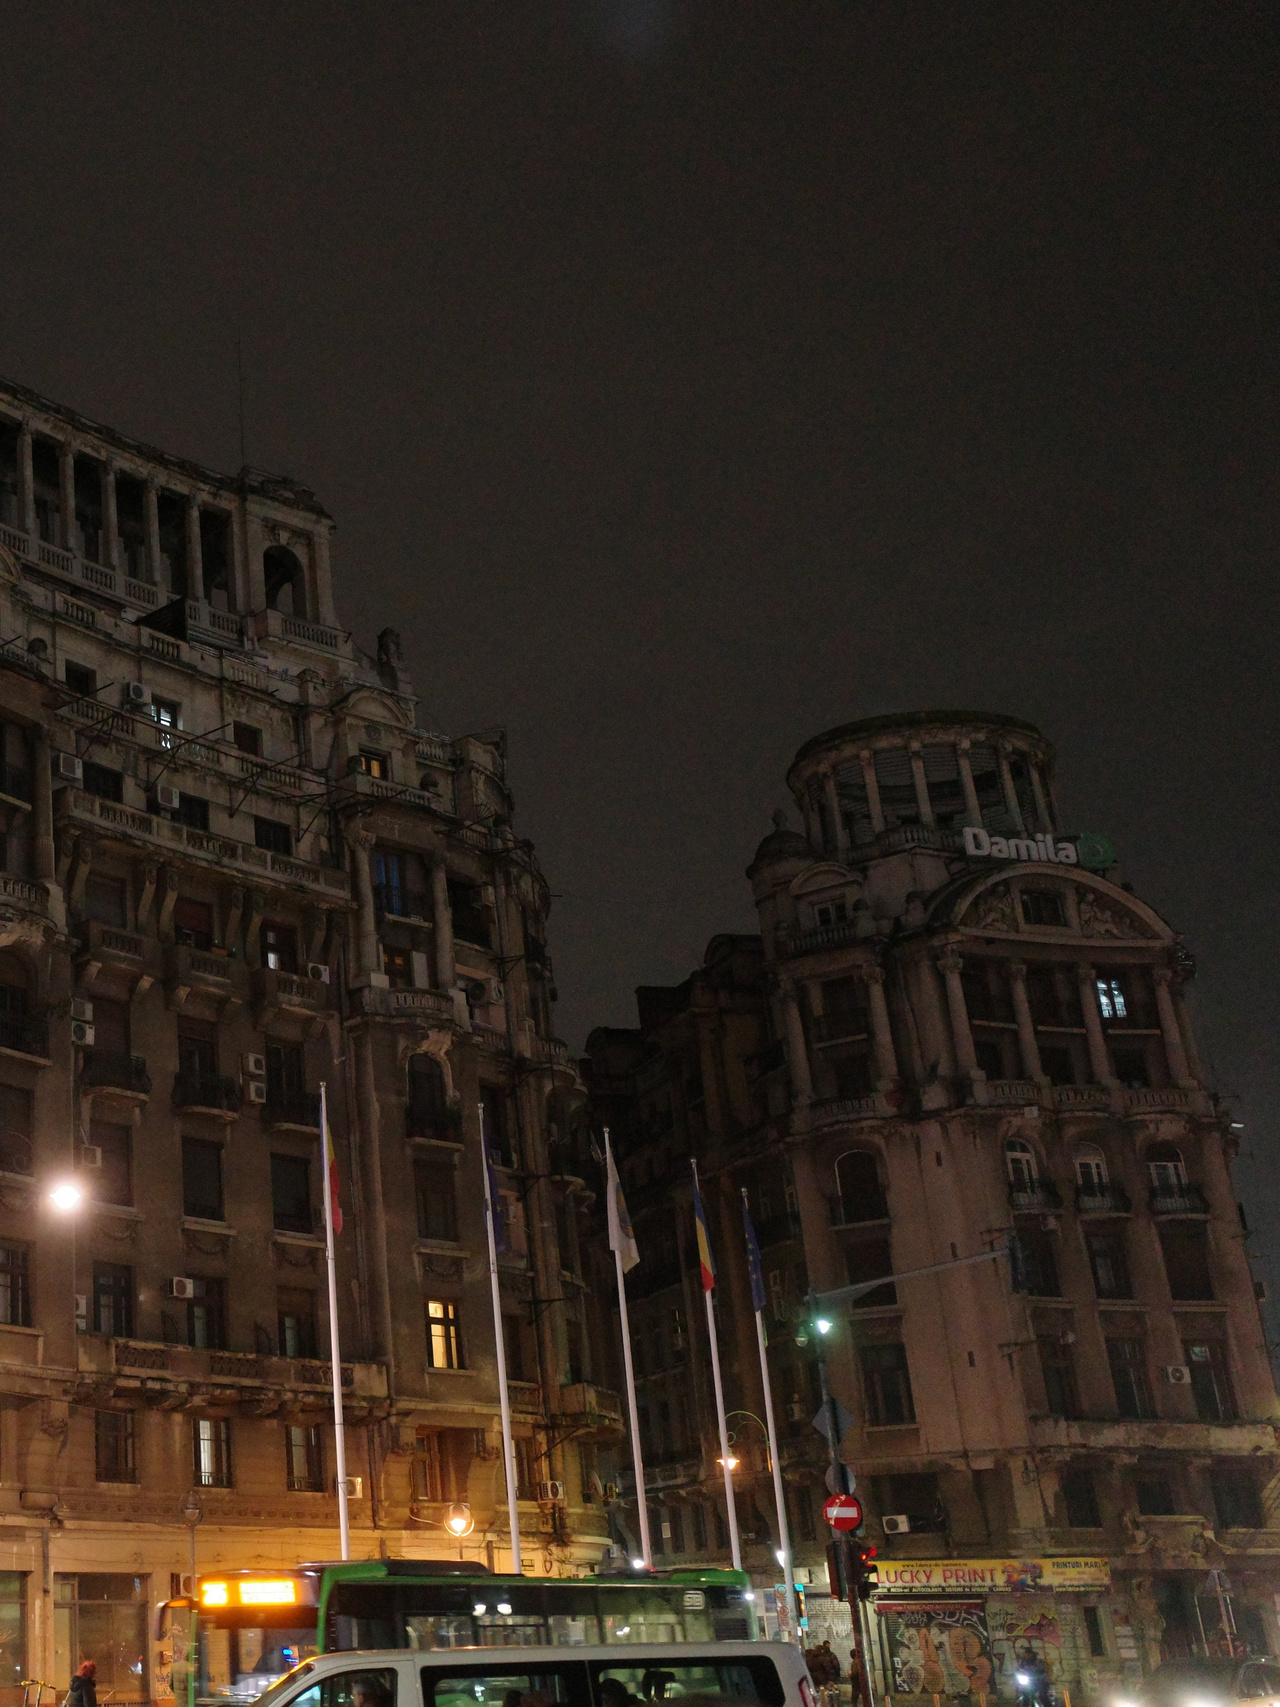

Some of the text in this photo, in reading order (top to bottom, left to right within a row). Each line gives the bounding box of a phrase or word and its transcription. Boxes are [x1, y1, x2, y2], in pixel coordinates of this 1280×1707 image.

[962, 826, 1078, 864] Damila
[876, 1568, 997, 1584] LUCKY PRINT
